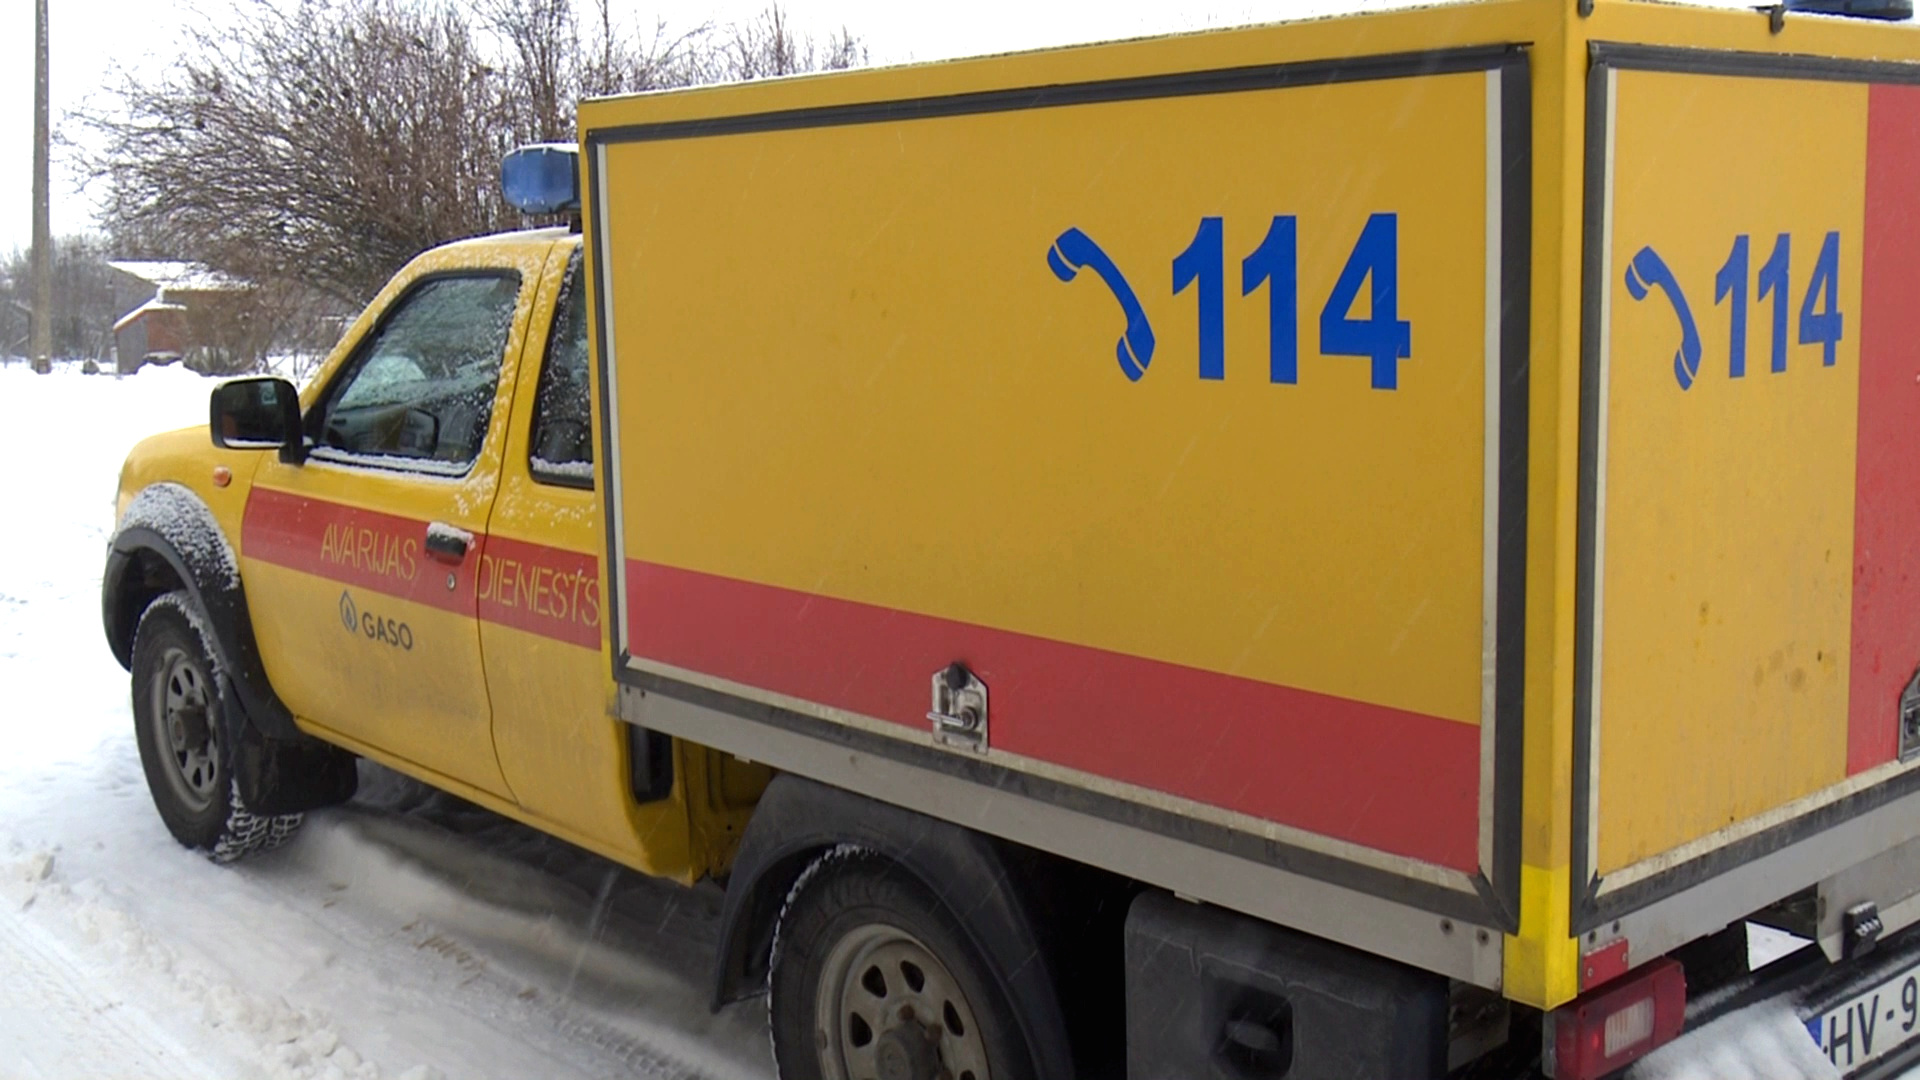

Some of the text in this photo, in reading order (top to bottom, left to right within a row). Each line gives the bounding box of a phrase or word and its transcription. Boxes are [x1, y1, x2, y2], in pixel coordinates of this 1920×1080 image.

[1172, 213, 1411, 390] 114
[1715, 231, 1842, 379] 114
[361, 611, 413, 651] GASO
[475, 553, 601, 627] DIENESTS
